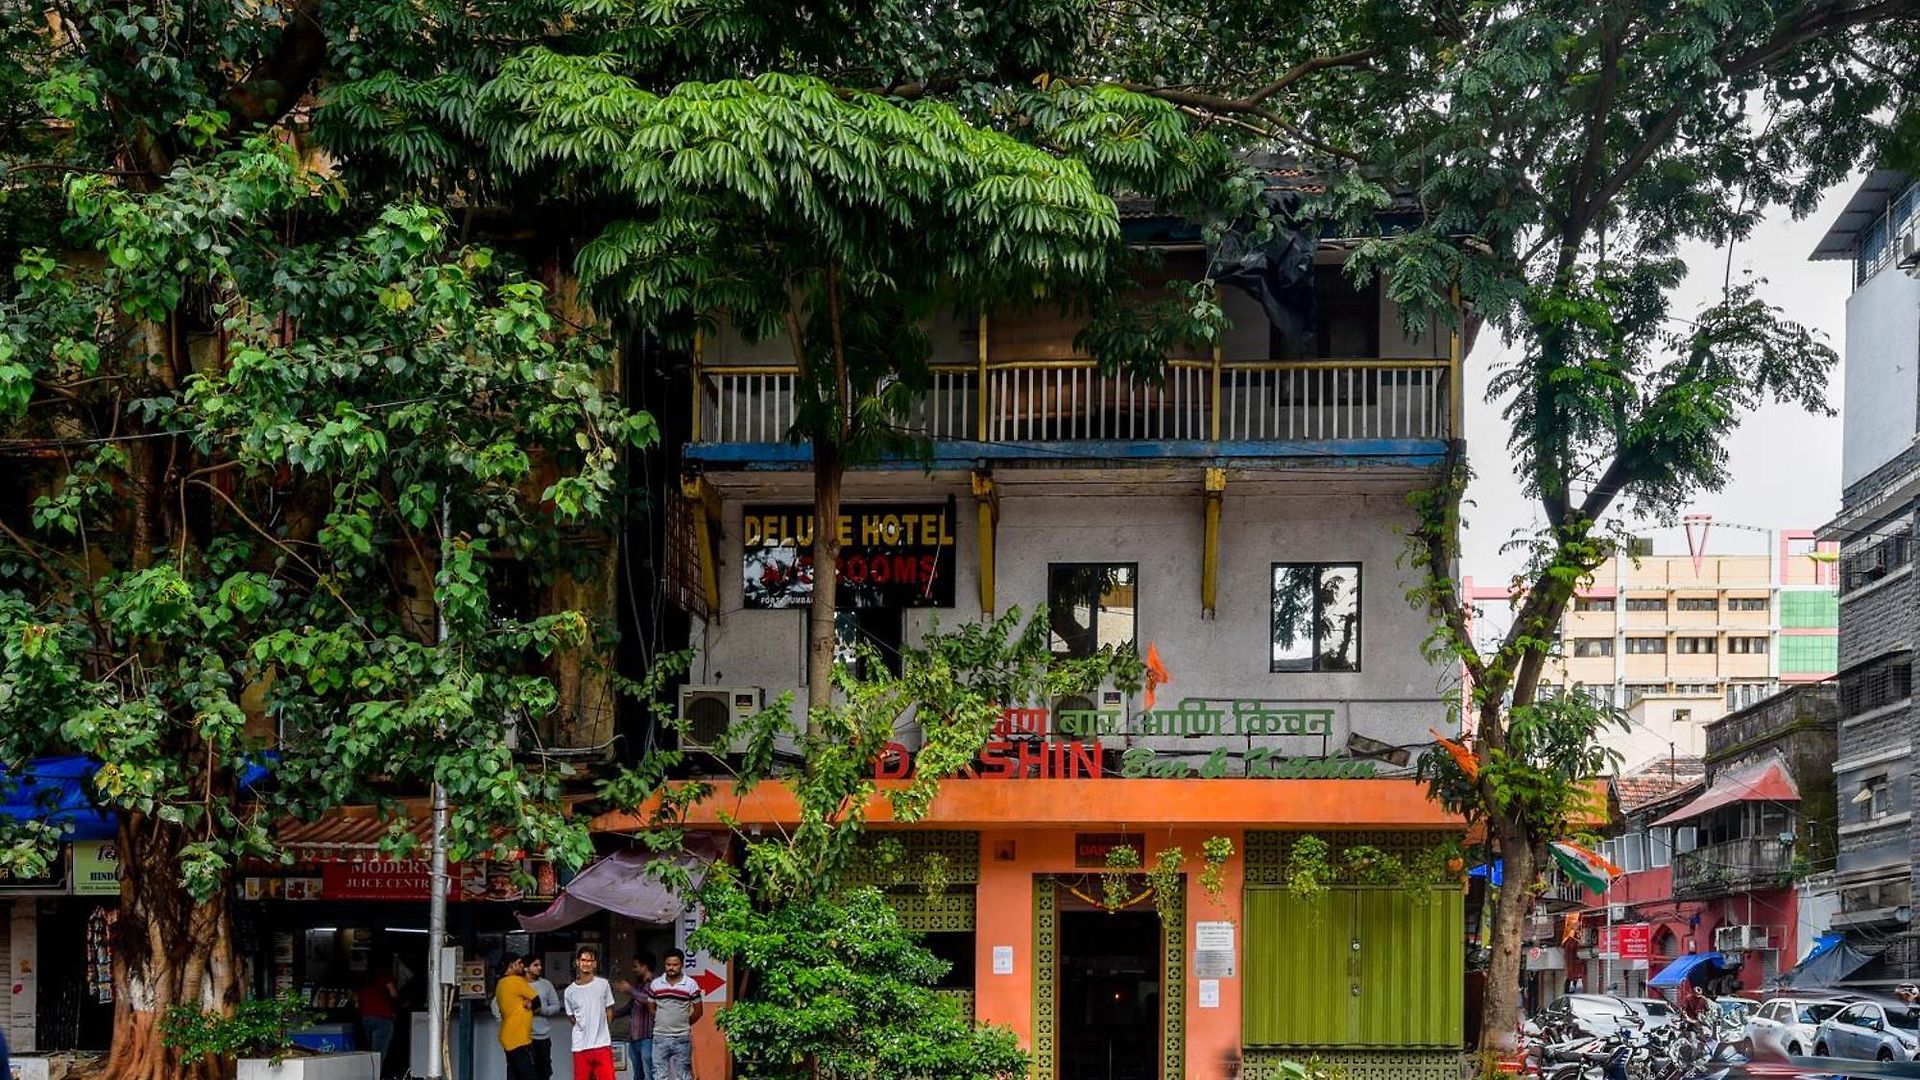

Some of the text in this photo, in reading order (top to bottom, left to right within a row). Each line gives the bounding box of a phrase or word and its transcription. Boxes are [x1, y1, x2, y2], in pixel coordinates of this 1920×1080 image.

[744, 513, 954, 547] DELUE HOTEL
[1059, 709, 1122, 737] बार
[1232, 698, 1335, 736] किचन
[874, 741, 1377, 780] DSHIN Bar & Kitchen
[345, 878, 431, 889] JUICE CENTR
